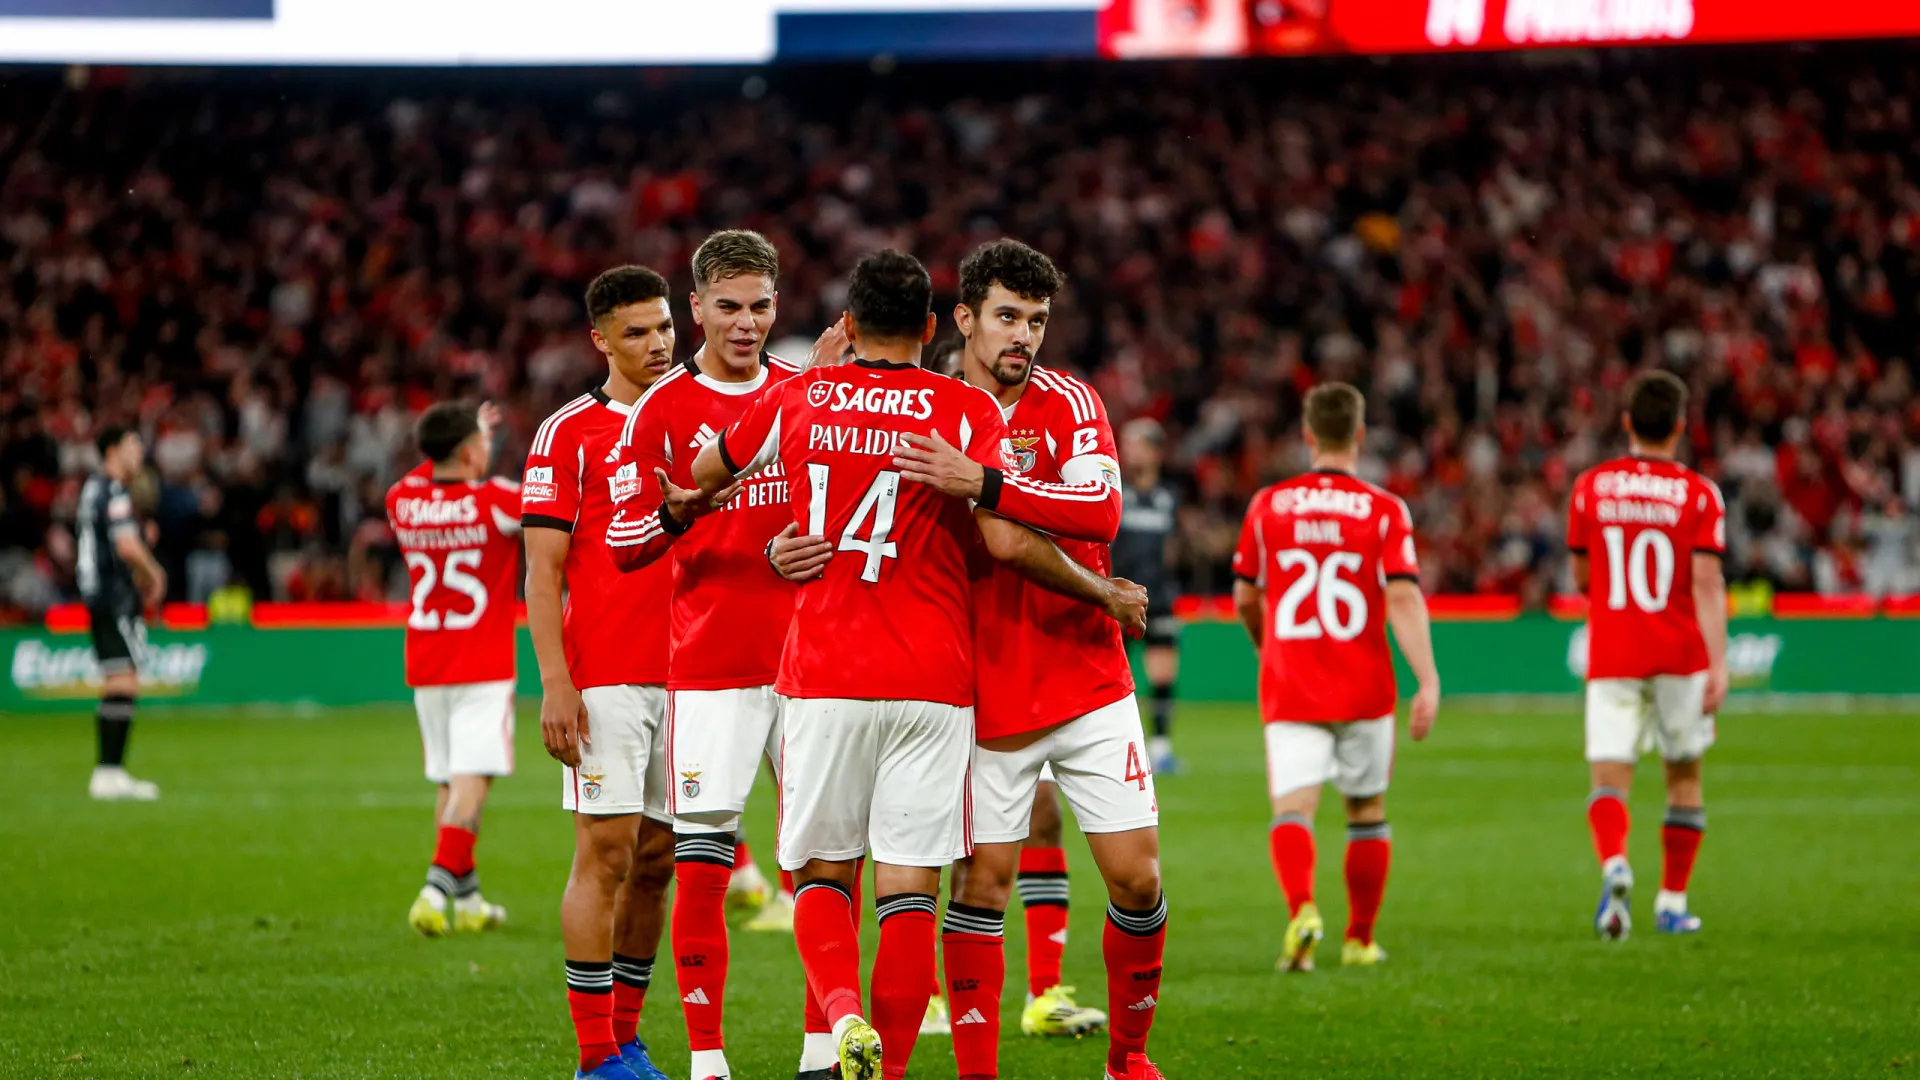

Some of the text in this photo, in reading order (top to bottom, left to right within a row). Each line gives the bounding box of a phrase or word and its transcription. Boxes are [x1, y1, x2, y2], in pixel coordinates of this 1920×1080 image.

[830, 383, 935, 421] SAGRES
[748, 480, 792, 507] BETTE
[807, 463, 901, 583] 14
[404, 549, 488, 631] 25
[1275, 548, 1368, 642] 26
[1602, 526, 1675, 615] 10
[1124, 741, 1153, 791] 4
